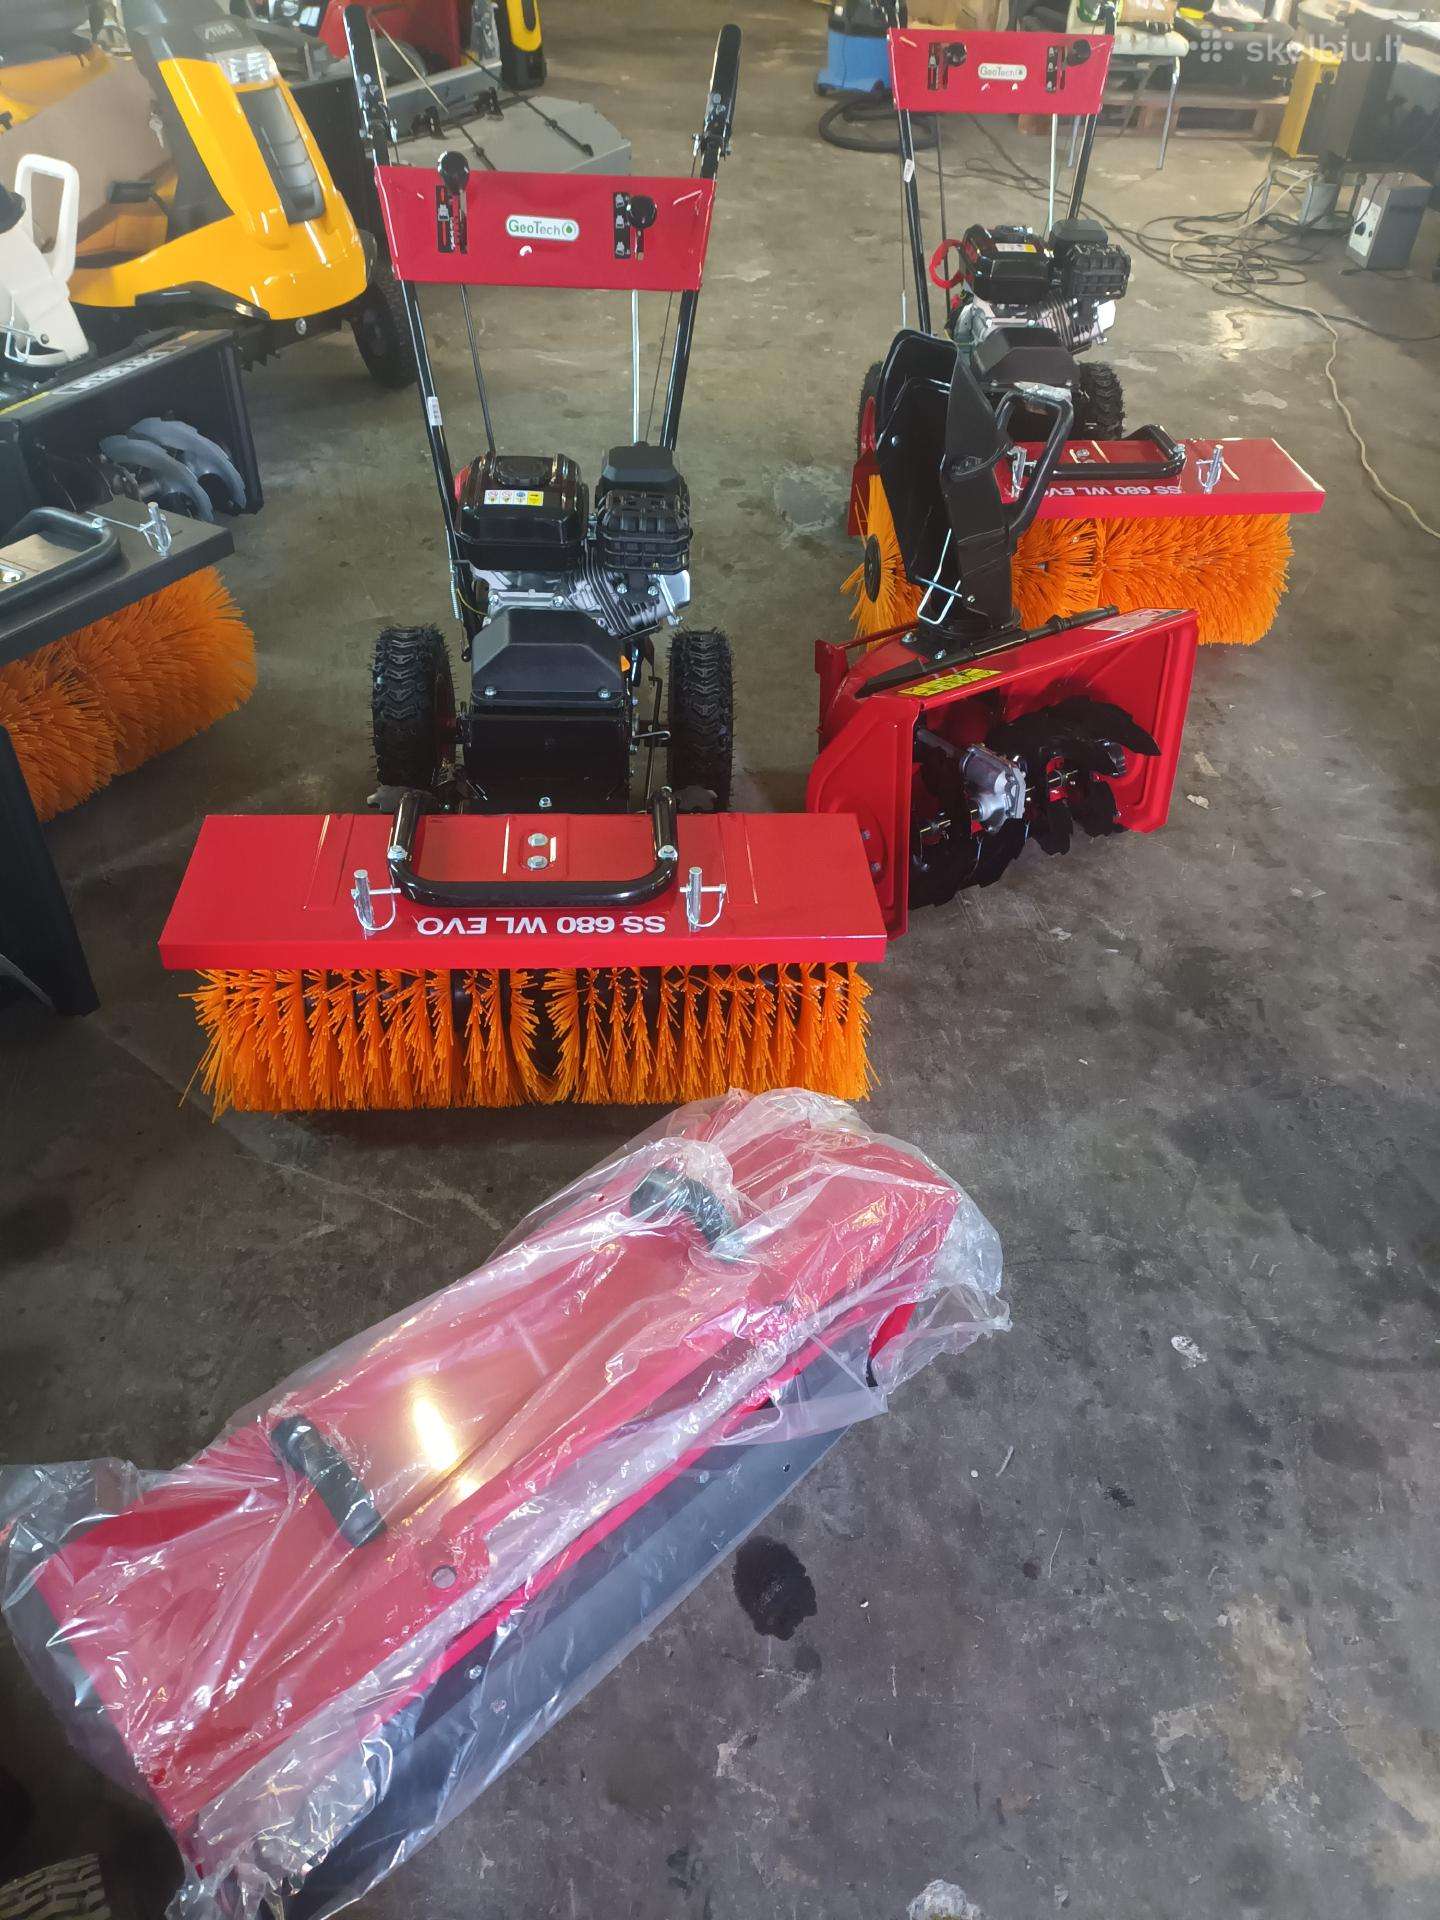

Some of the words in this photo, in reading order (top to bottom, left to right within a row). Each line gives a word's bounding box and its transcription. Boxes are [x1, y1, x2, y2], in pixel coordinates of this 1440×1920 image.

[508, 219, 561, 236] GeoTech
[1044, 487, 1075, 497] EV
[1077, 487, 1112, 496] WL
[1114, 486, 1151, 495] 680
[1154, 486, 1183, 495] SS
[417, 917, 488, 935] EVO
[496, 917, 548, 934] WL
[556, 916, 615, 934] 680
[622, 915, 666, 934] SS
